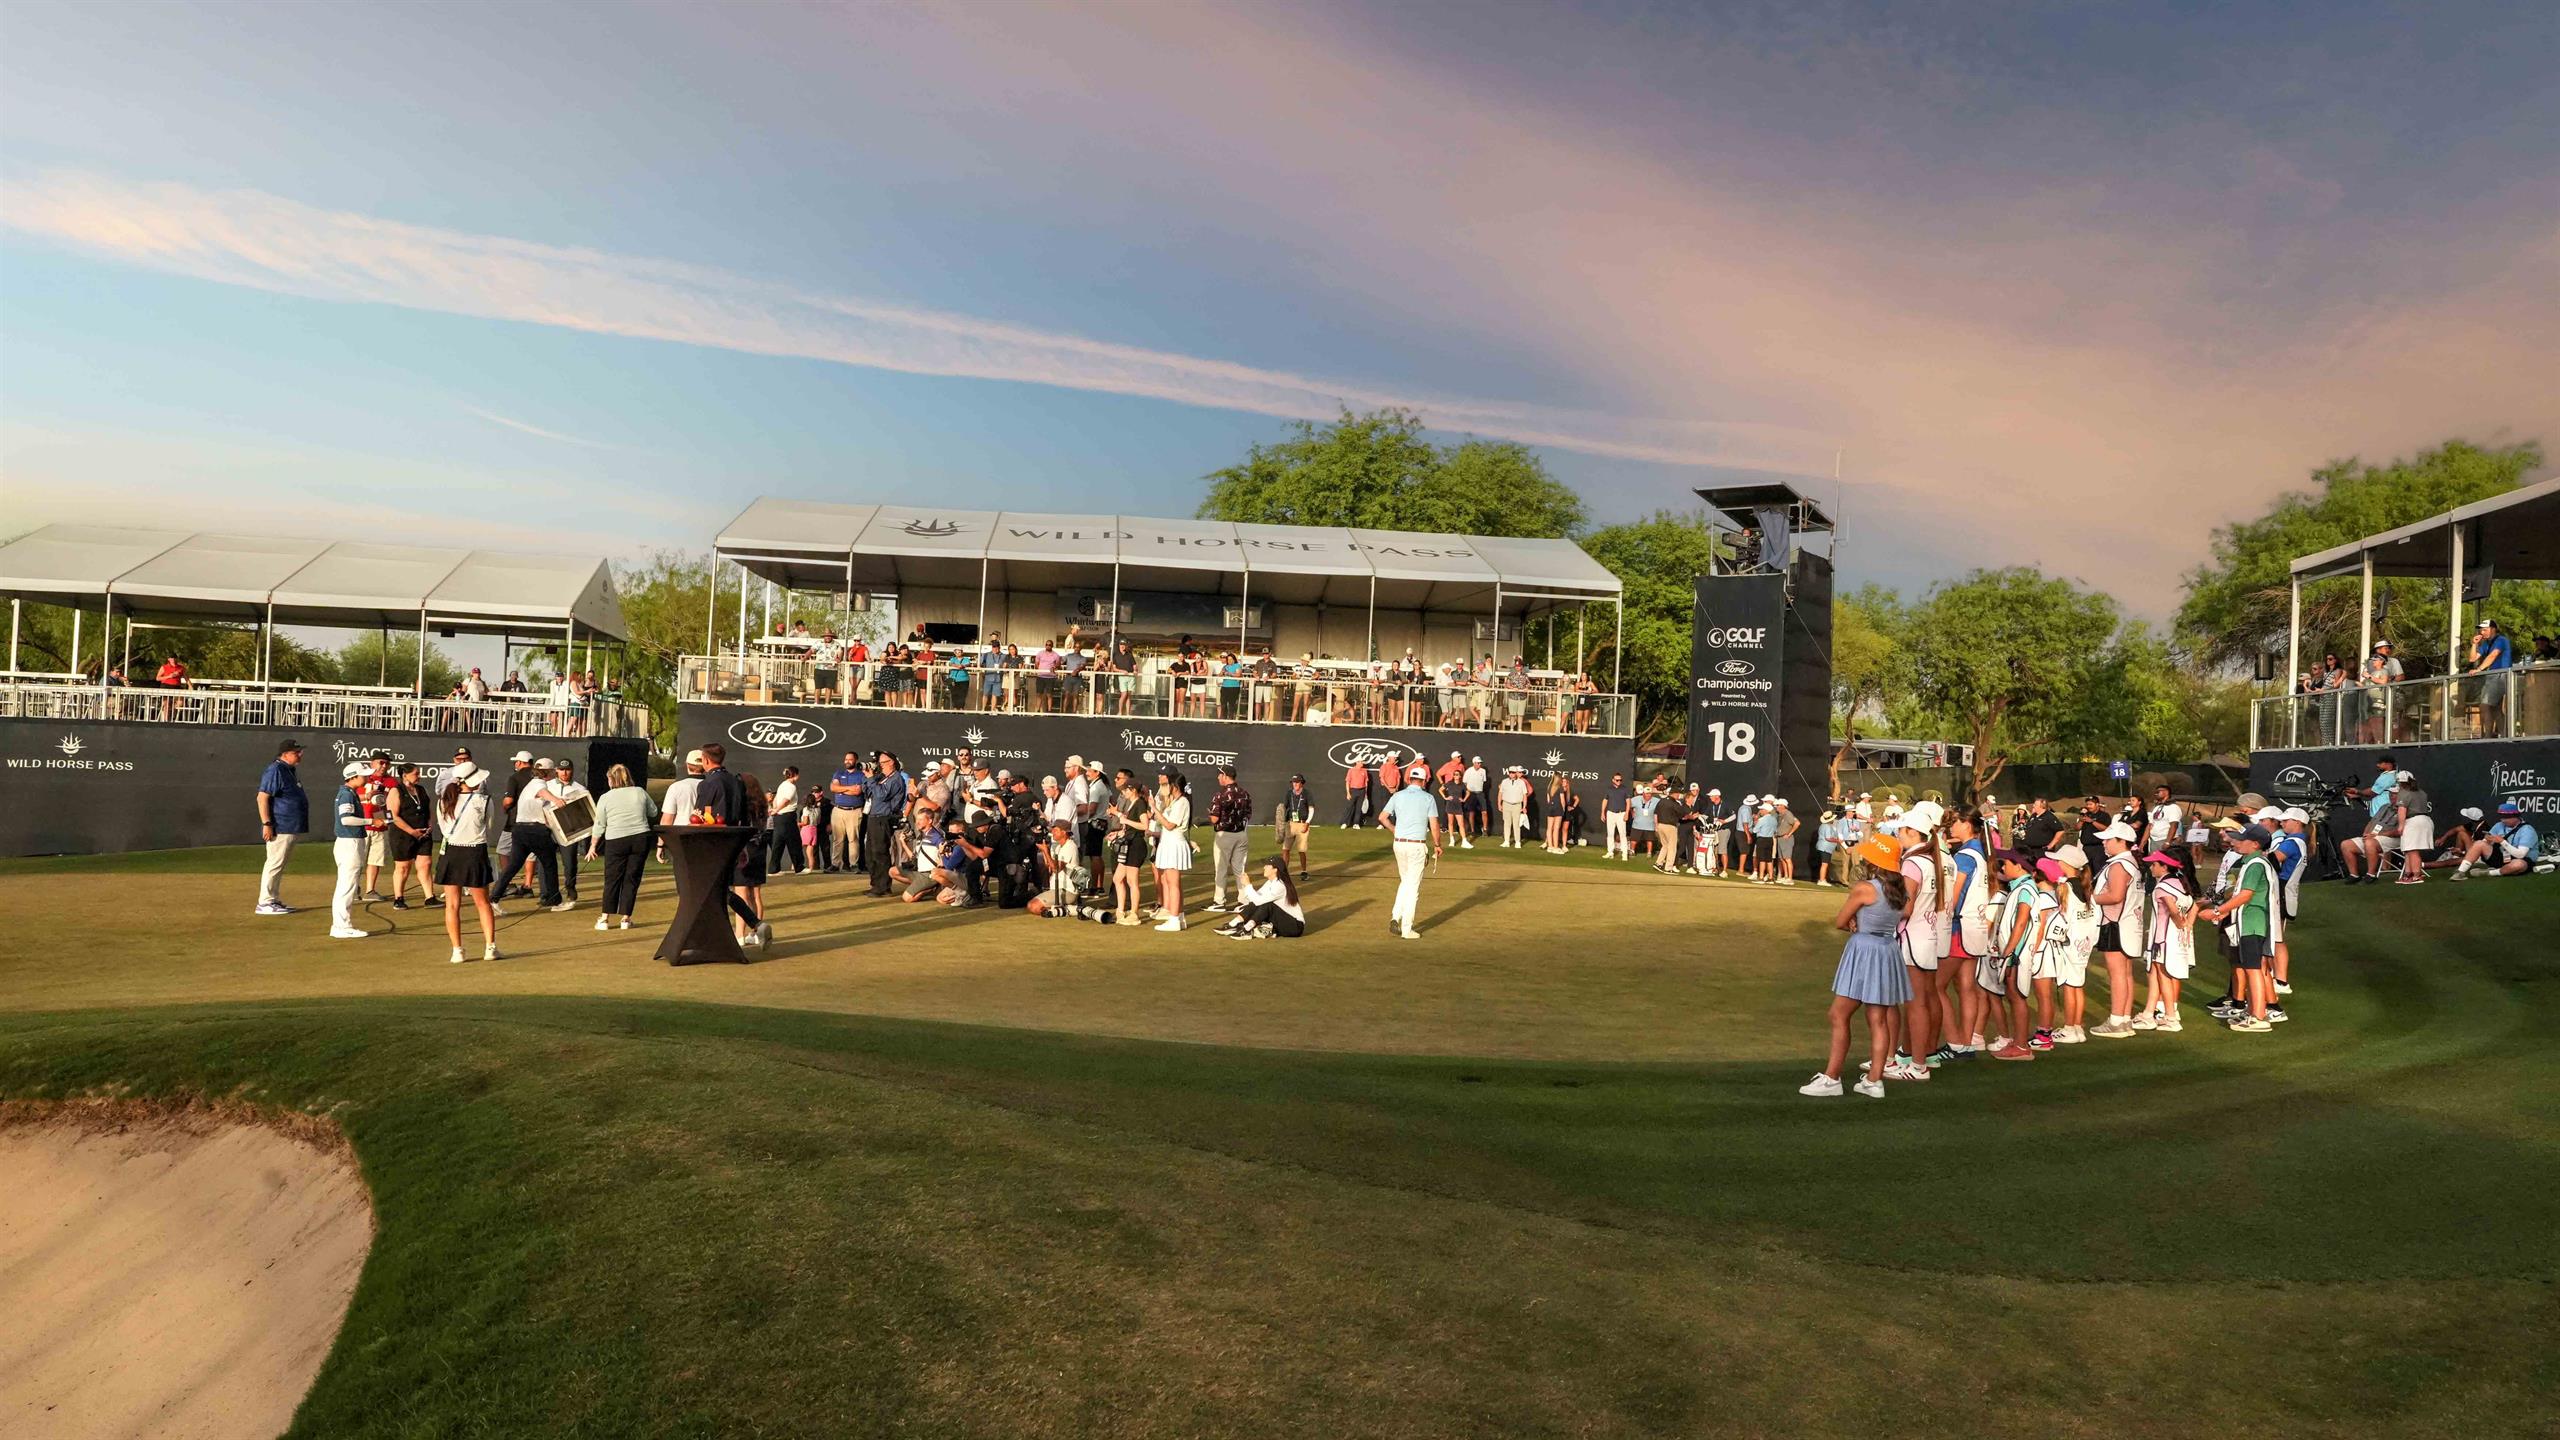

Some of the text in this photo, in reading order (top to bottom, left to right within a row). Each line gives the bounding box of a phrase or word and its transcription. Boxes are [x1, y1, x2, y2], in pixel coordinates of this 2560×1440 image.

[1009, 528, 1474, 558] WILD HORSE PASS
[1726, 628, 1766, 643] GOLF
[1722, 661, 1748, 674] Ford
[1697, 678, 1772, 692] Championship
[747, 720, 807, 744] Ford
[1135, 735, 1172, 747] RACE
[1708, 721, 1755, 763] 18
[922, 747, 952, 756] WILD
[1000, 750, 1030, 759] PASS
[1157, 752, 1235, 767] CME GLOBE
[7, 759, 134, 770] WILD HORSE PASS
[1571, 771, 1599, 780] PASS
[2113, 768, 2126, 777] 18
[2501, 769, 2546, 787] RACE TO
[2517, 796, 2544, 813] CME
